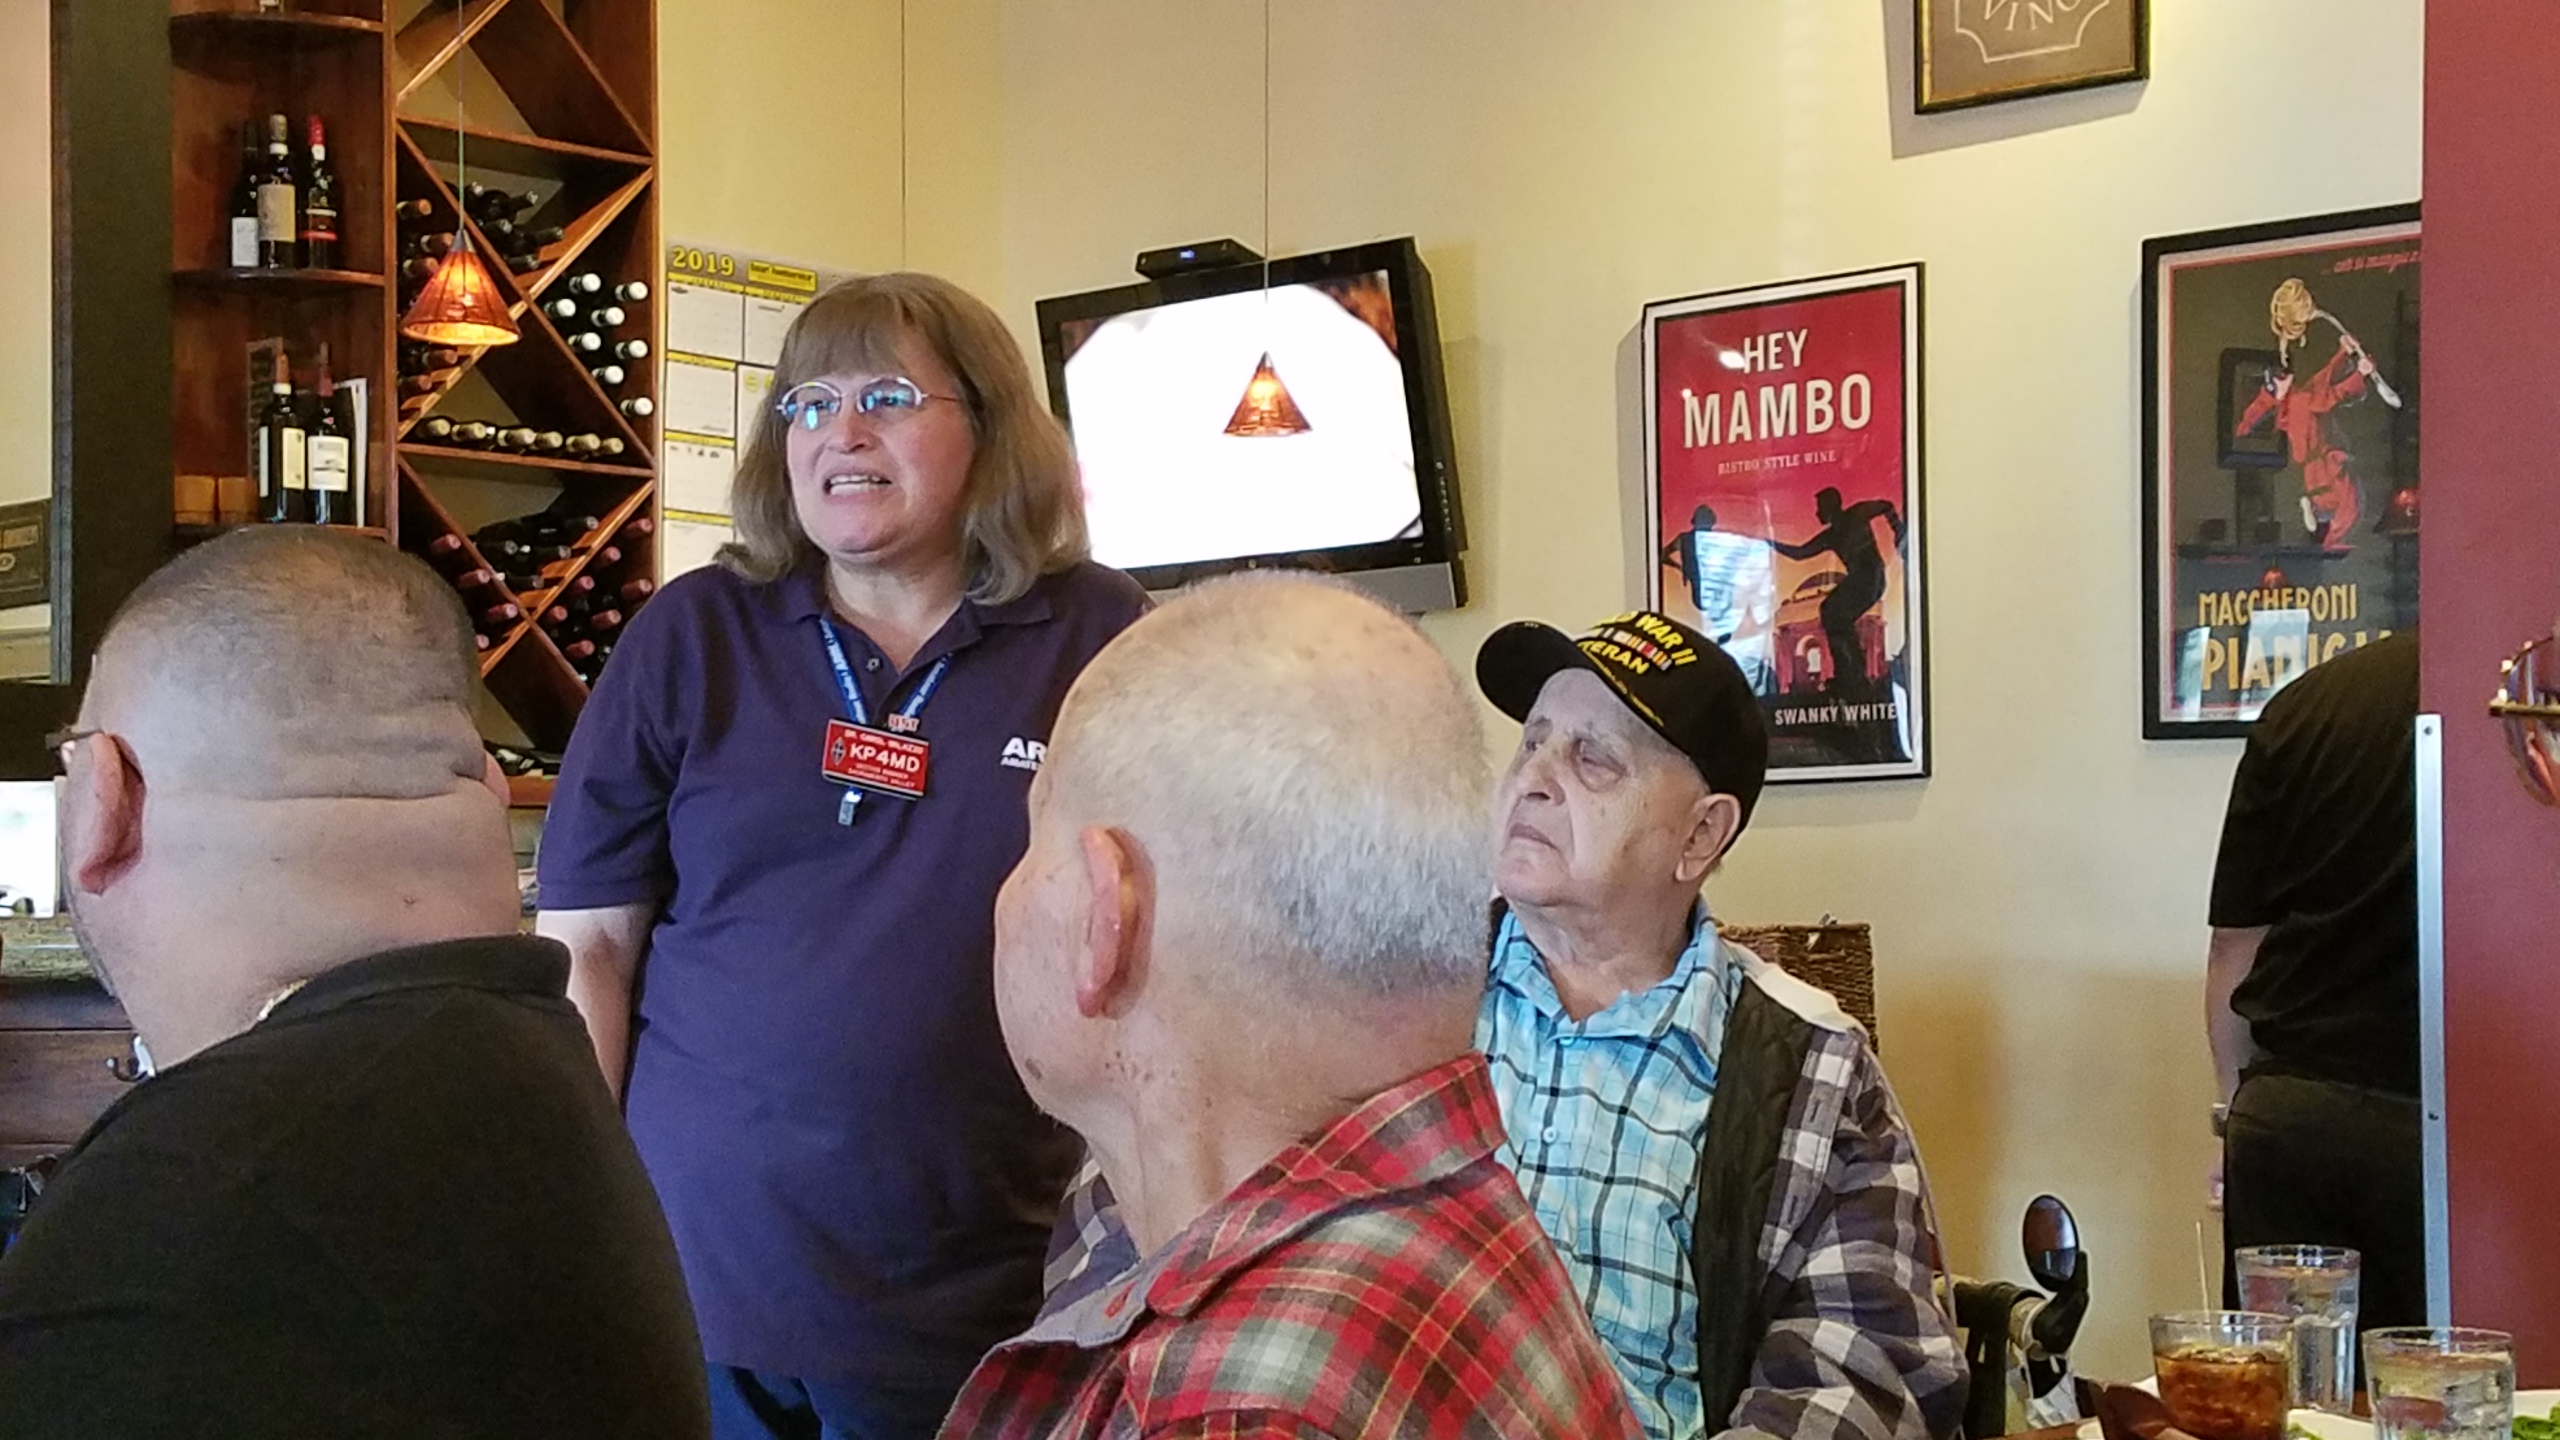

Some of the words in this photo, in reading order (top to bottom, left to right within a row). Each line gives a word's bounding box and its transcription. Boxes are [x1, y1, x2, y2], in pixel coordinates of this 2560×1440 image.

[672, 247, 735, 276] 2019
[1743, 328, 1808, 374] HEY
[1684, 373, 1872, 449] MAMBO
[1718, 459, 1760, 475] BISTRO
[1764, 454, 1800, 469] STYLE
[1804, 450, 1837, 465] WINE
[2199, 584, 2358, 627] MACCHERONI
[1635, 613, 1684, 649] WAR
[1576, 640, 1650, 675] TERAN
[1774, 706, 1838, 726] SWANKY
[1844, 703, 1898, 722] WHITE
[849, 742, 921, 773] KP4MD
[1001, 736, 1047, 764] AR
